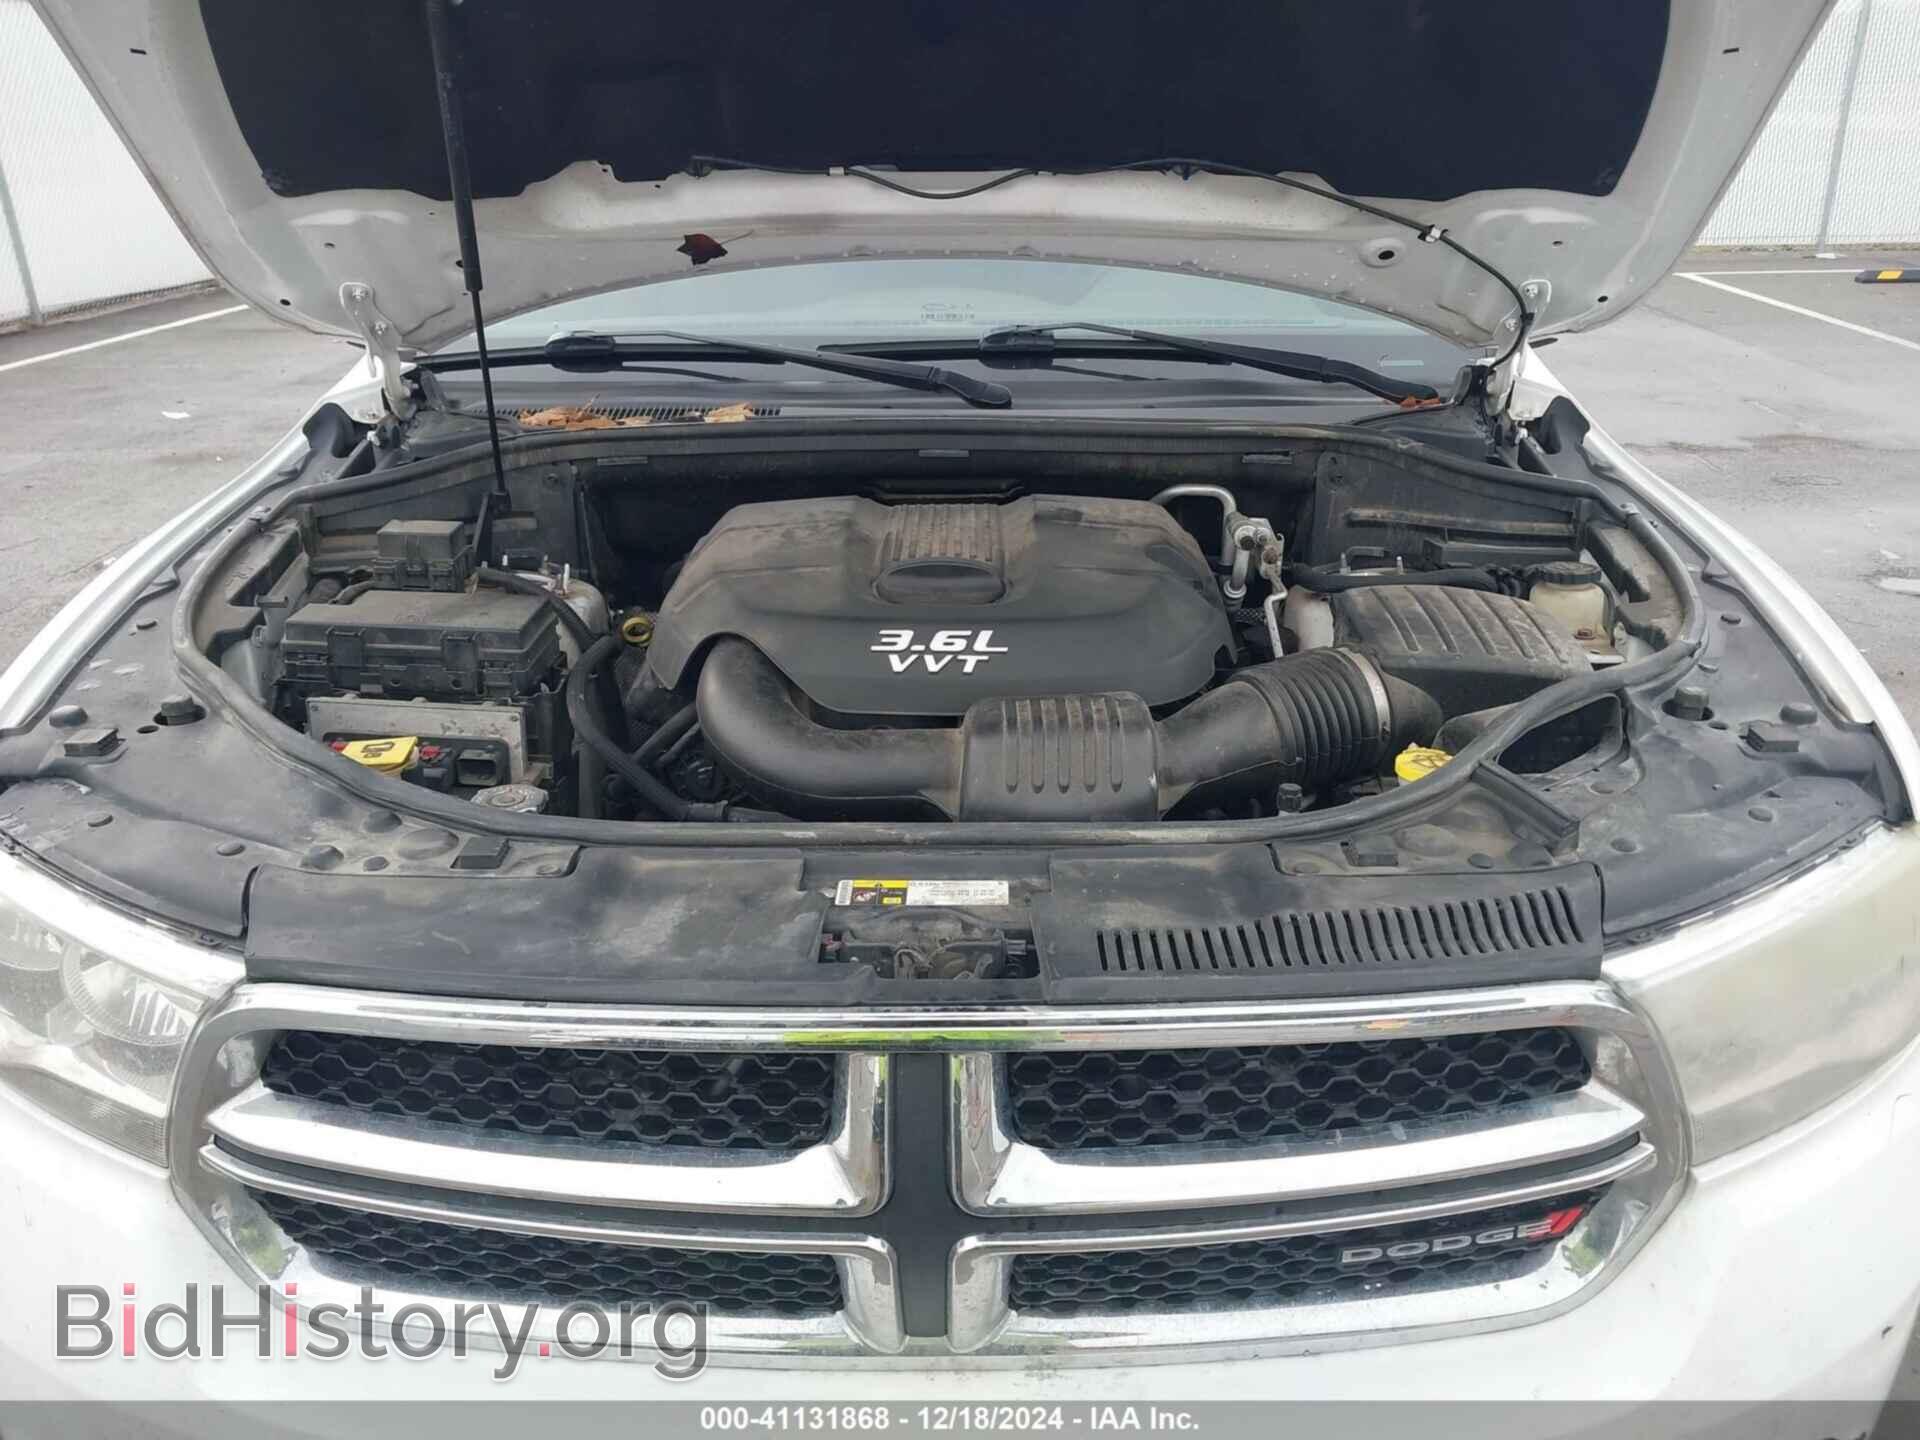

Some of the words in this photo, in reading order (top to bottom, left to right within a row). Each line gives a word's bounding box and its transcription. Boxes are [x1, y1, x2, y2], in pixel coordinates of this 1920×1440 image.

[870, 629, 1009, 653] 3.6L
[888, 653, 990, 673] VVT
[1341, 1218, 1553, 1264] DODGE
